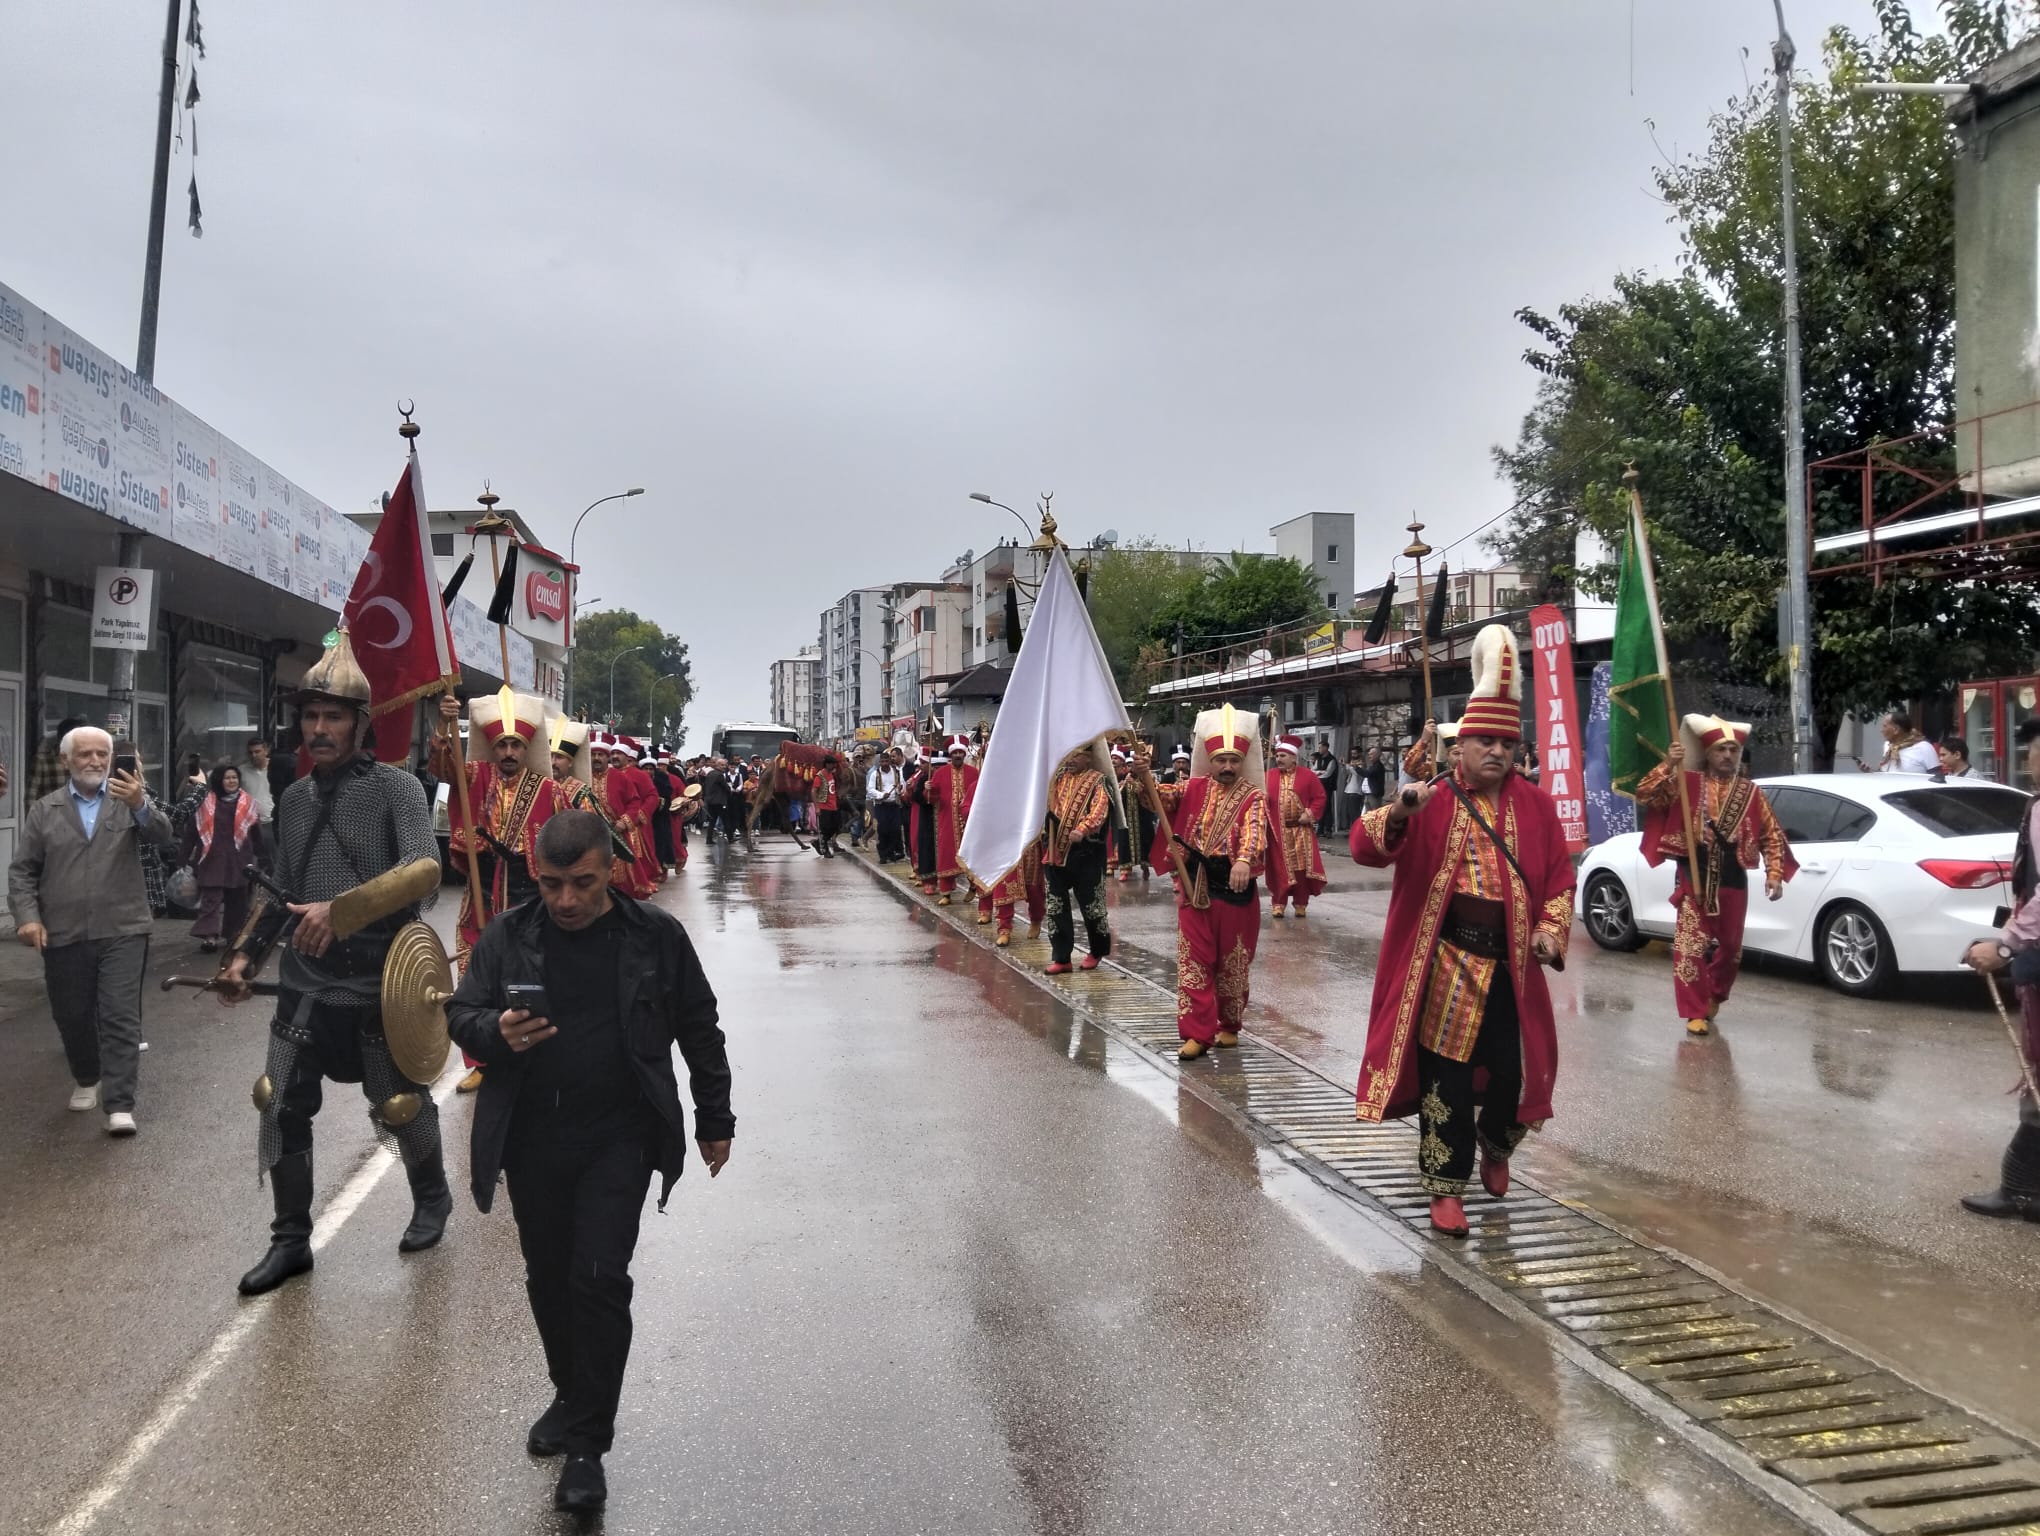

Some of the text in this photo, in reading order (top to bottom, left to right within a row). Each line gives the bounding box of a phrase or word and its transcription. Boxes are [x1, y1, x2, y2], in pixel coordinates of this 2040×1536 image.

[62, 343, 110, 398] Sistem
[177, 441, 210, 481] Sistem
[61, 467, 109, 513] Sistem
[120, 470, 160, 514] Sistem
[229, 500, 256, 535] Sistem
[267, 506, 290, 538] Sistem
[536, 584, 561, 610] emsal
